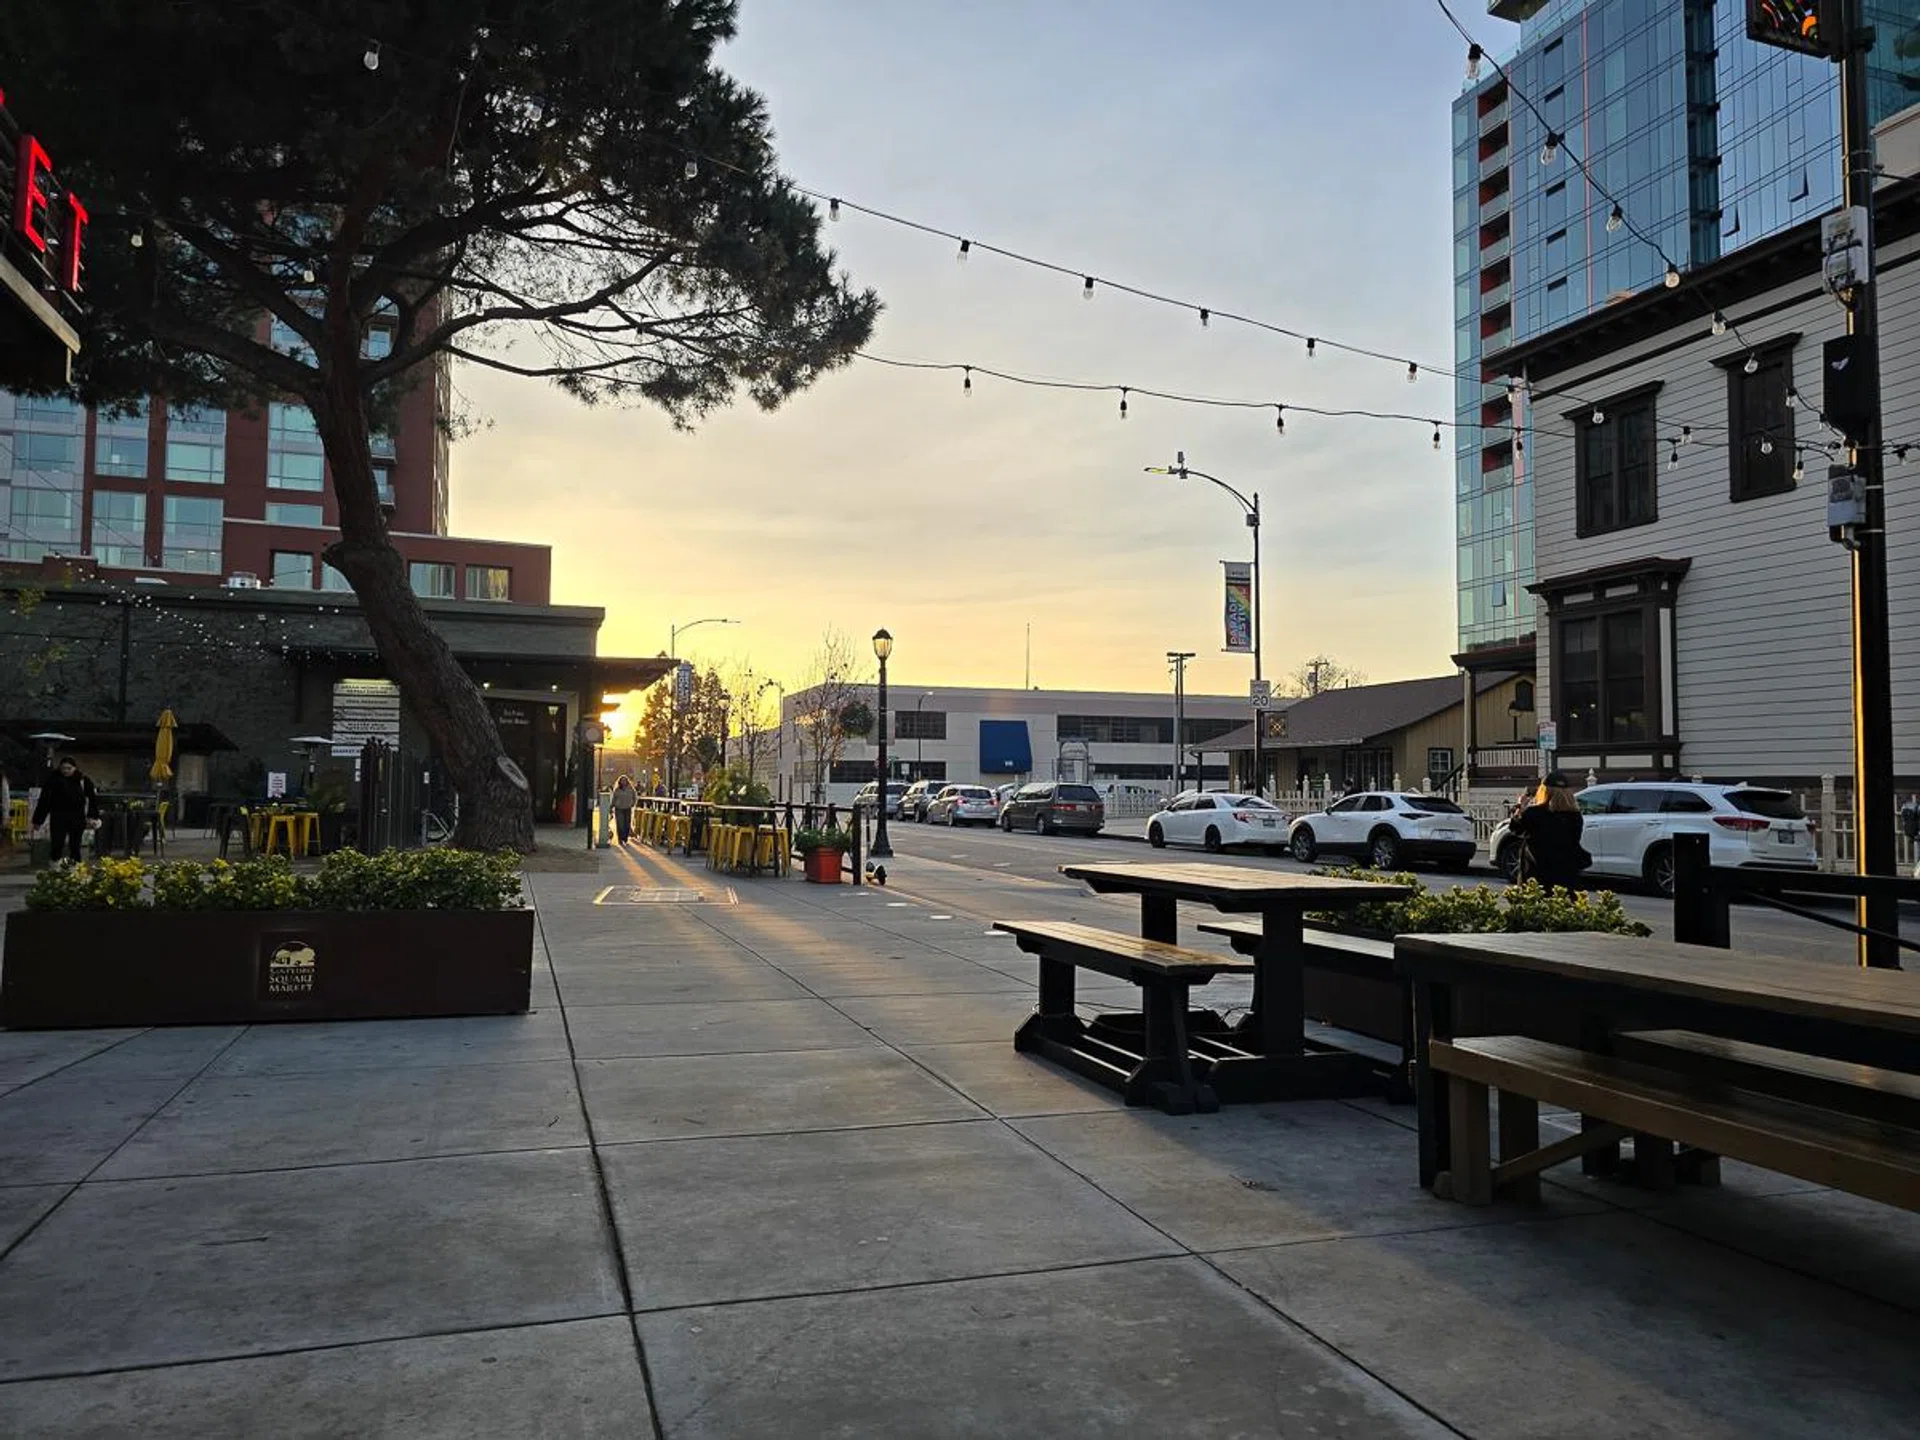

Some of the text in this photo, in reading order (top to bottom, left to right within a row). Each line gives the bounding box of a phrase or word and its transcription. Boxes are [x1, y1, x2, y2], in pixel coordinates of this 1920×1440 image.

[0, 84, 88, 291] ET
[1238, 592, 1247, 645] FESTIV
[1253, 694, 1268, 707] 20
[269, 974, 313, 984] SQUARE
[269, 984, 313, 992] MARKET
